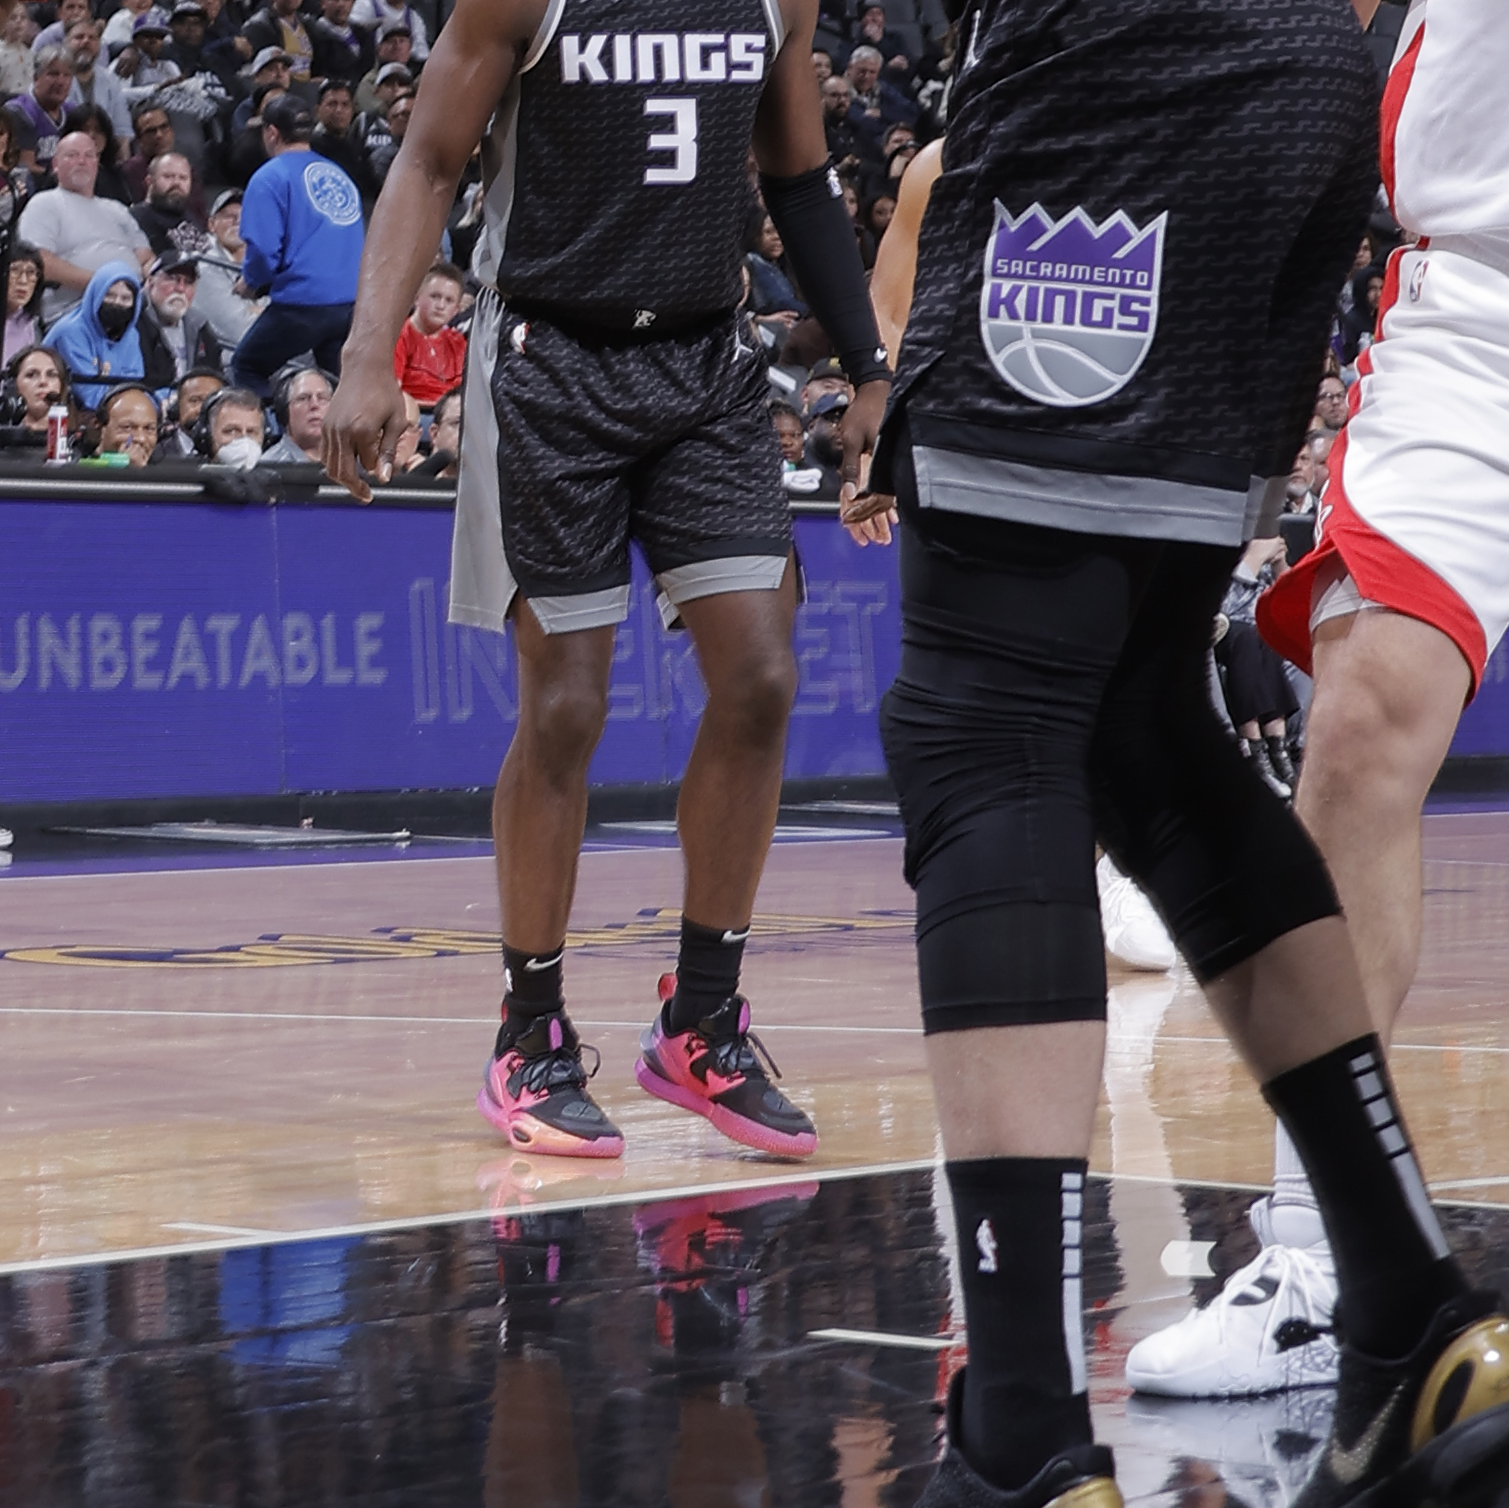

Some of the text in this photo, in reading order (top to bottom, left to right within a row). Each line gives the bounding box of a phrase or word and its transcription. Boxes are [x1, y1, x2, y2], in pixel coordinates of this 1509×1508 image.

[560, 32, 767, 84] KINGS
[643, 97, 699, 185] 3
[995, 258, 1151, 287] SACRAMENTO
[986, 281, 1153, 334] KINGS
